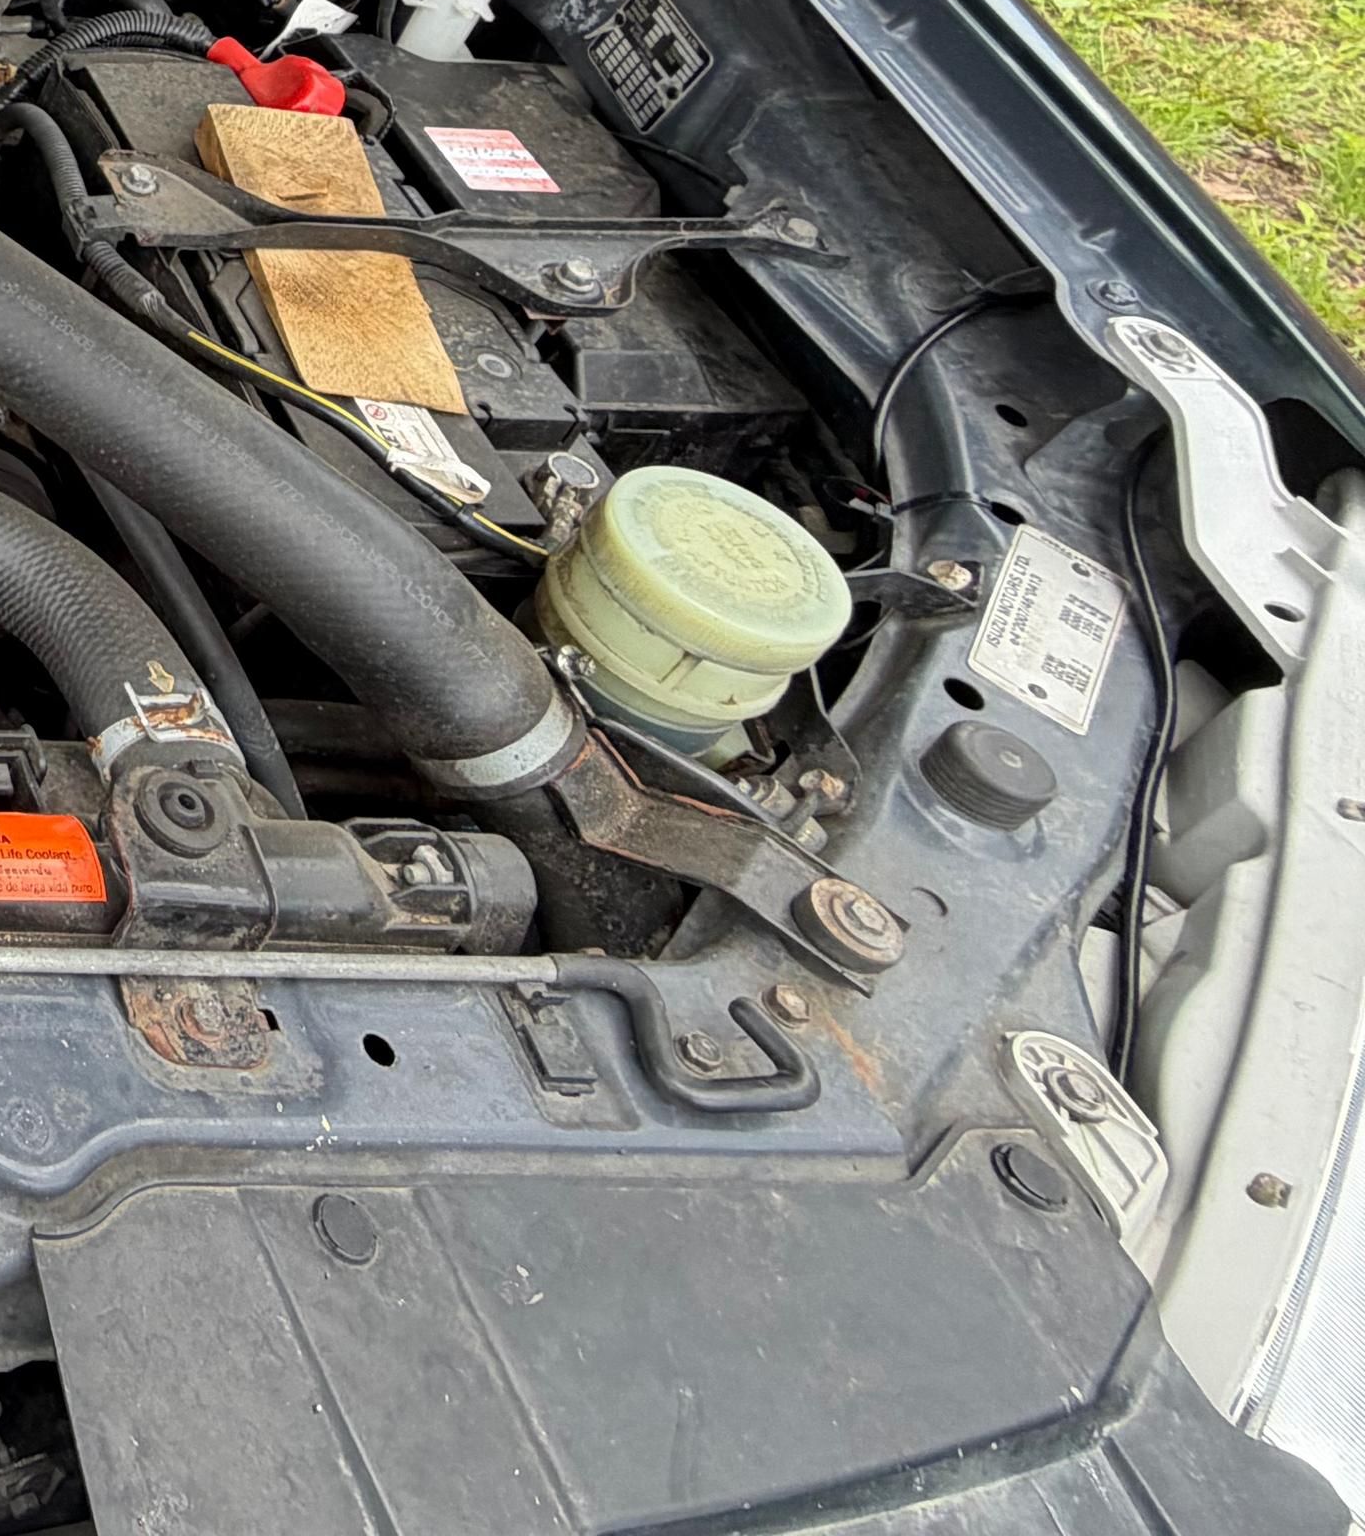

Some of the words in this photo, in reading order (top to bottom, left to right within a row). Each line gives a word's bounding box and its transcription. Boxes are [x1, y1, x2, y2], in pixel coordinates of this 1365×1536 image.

[987, 615, 1007, 648] ISUZU
[998, 574, 1022, 616] MOTORS
[0, 848, 23, 860] Life
[25, 849, 77, 861] Coolant.
[6, 881, 19, 892] de
